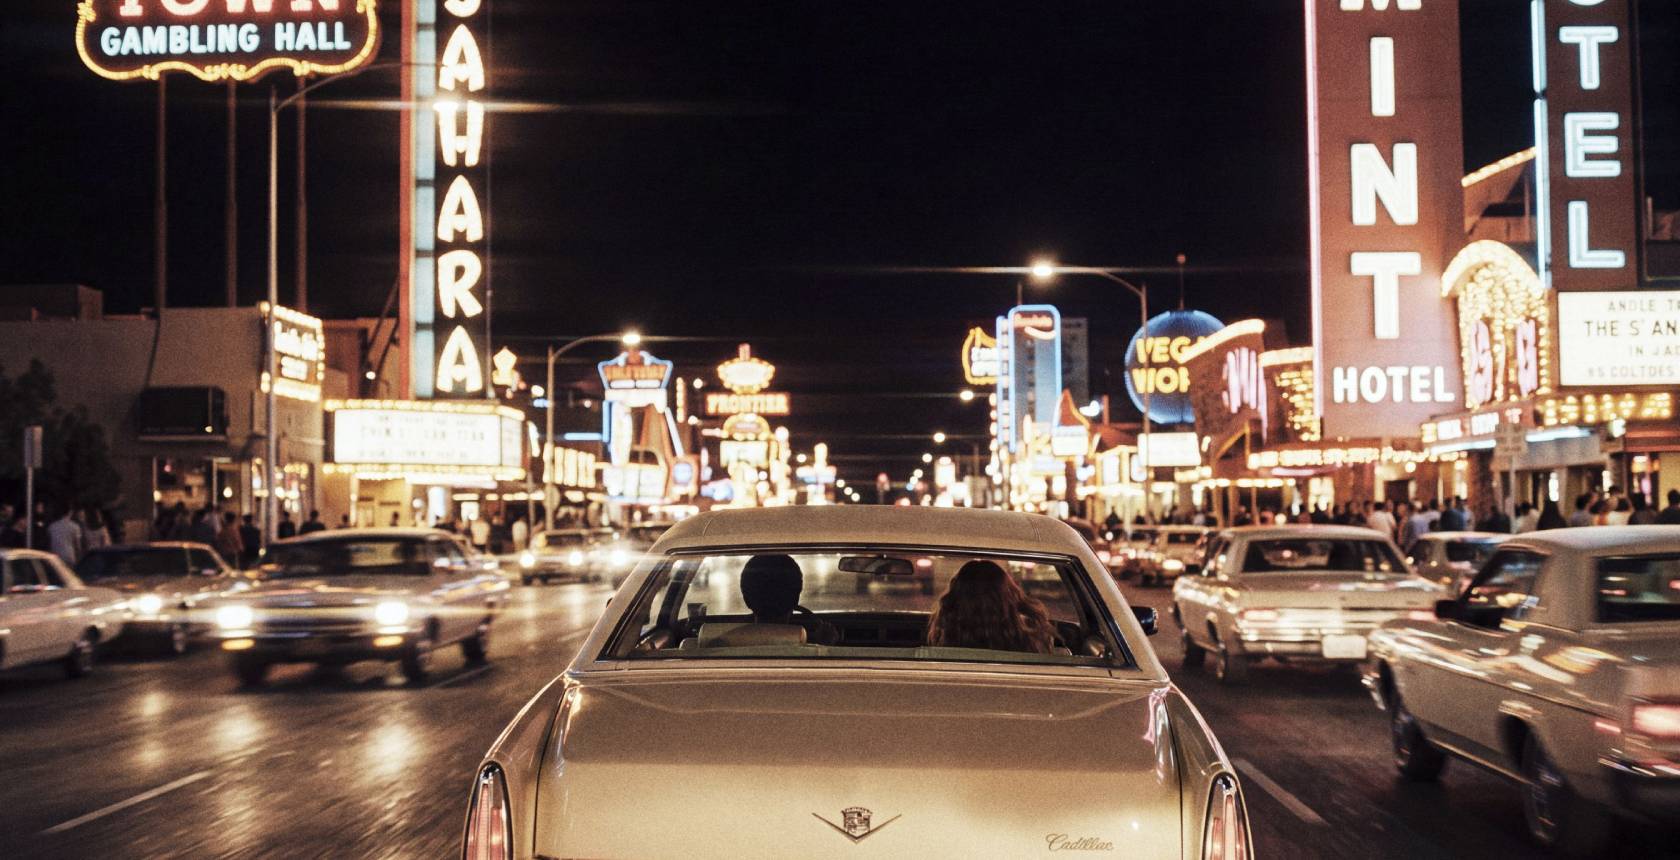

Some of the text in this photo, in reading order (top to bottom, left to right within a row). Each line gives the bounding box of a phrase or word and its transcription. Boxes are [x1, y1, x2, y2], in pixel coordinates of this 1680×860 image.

[100, 21, 351, 56] GAMBLING HALL
[1558, 0, 1626, 268] TEL
[1339, 0, 1423, 340] INT
[435, 0, 486, 393] AHARA
[1584, 320, 1619, 337] THE
[1135, 335, 1209, 365] VEG
[1332, 365, 1456, 404] HOTEL
[1044, 833, 1115, 852] Cadillac
